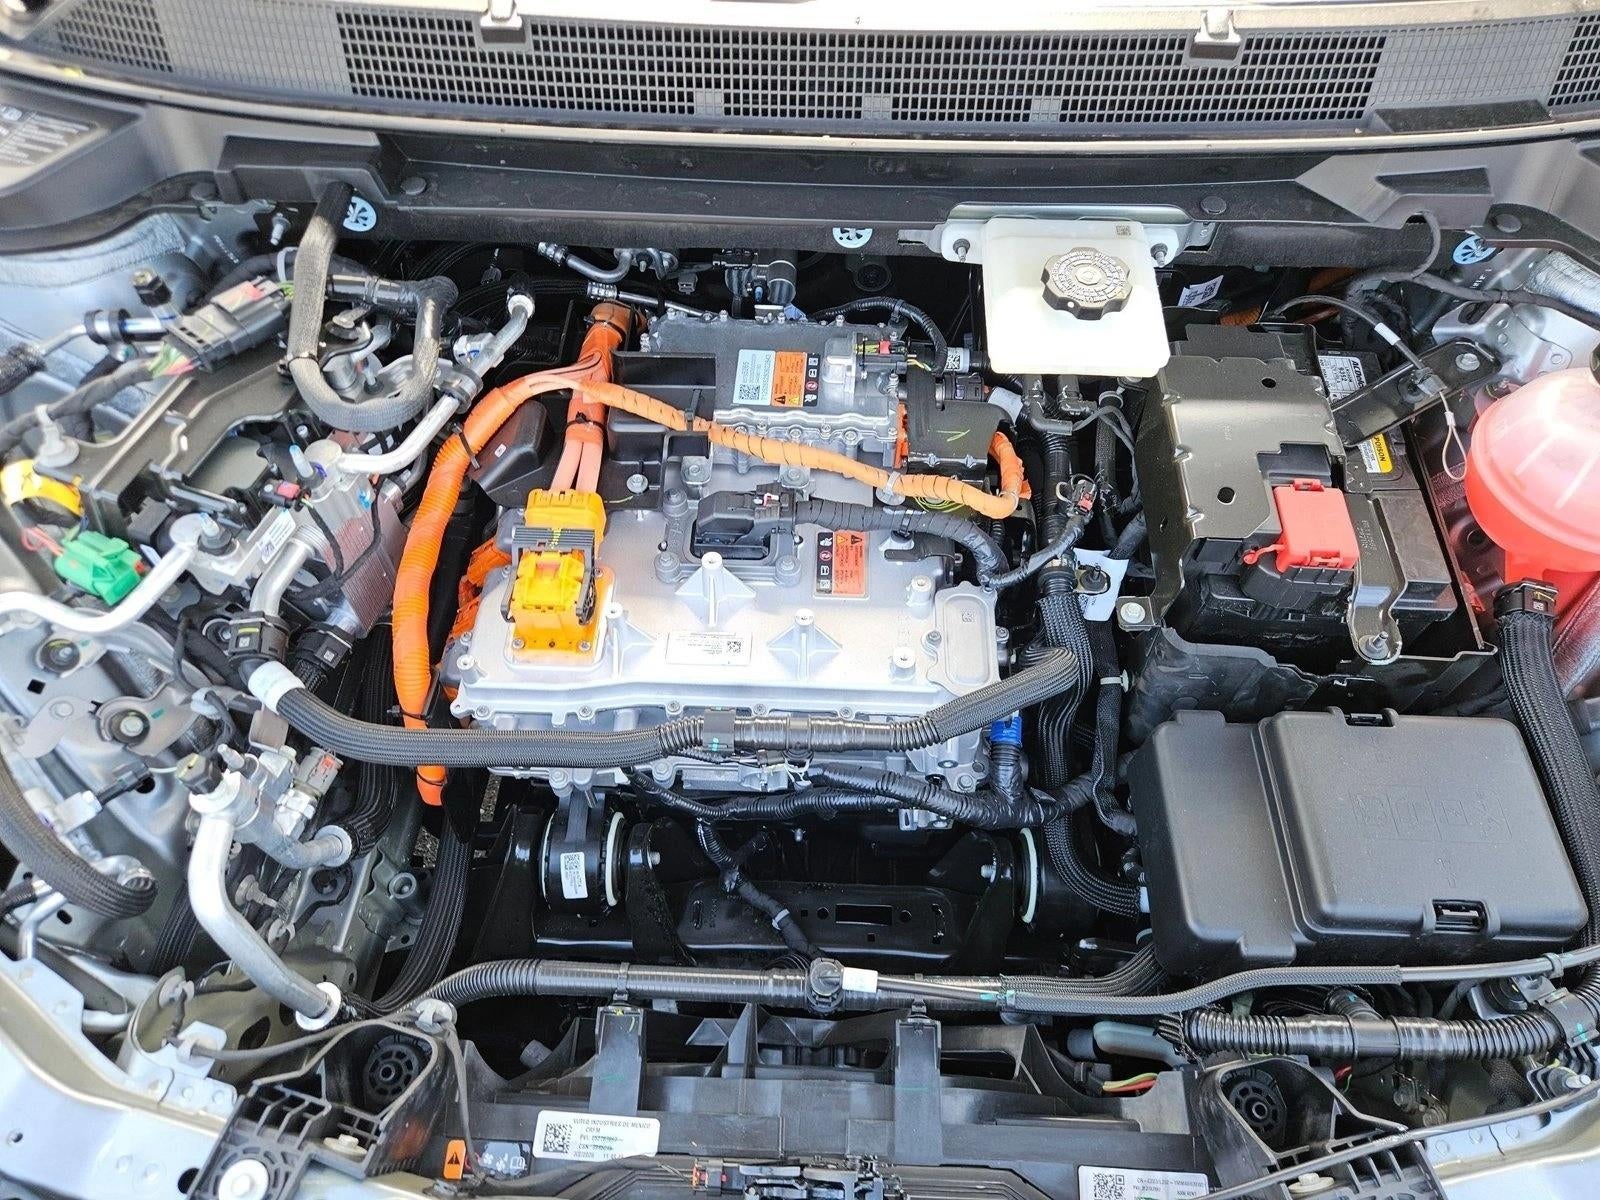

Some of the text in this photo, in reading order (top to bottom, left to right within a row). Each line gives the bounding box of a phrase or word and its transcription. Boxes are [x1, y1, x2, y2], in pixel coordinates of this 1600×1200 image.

[1351, 360, 1365, 388] ACDelc
[1373, 437, 1387, 462] POISON
[591, 1119, 622, 1127] INDUSTRIES
